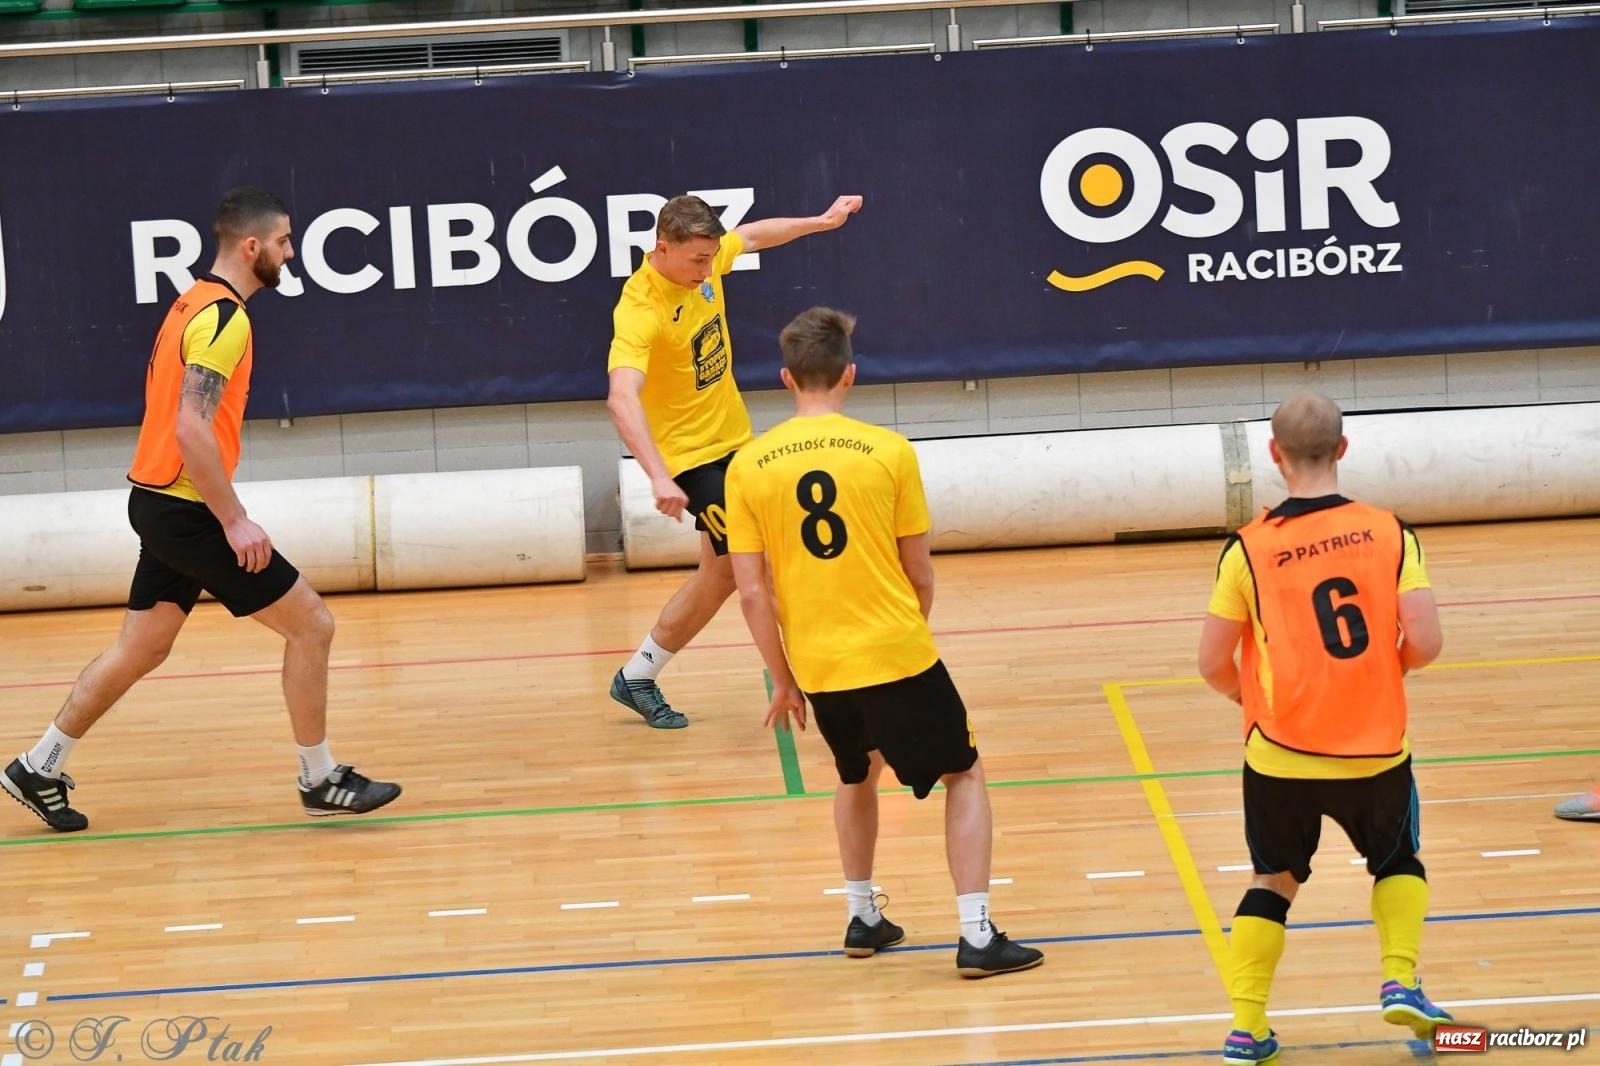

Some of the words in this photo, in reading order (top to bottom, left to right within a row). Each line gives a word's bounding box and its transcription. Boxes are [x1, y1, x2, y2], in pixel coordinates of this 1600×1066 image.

[1040, 116, 1401, 243] OSiR
[131, 165, 761, 305] RCIBÓRZ
[1188, 236, 1403, 284] RACIBÓRZ
[756, 437, 826, 469] PRZYSZŁOŚĆ
[830, 438, 874, 455] ROGÓW
[699, 503, 728, 542] 10
[796, 470, 848, 559] 8
[1296, 529, 1375, 560] PATRICK
[1312, 577, 1369, 659] 6
